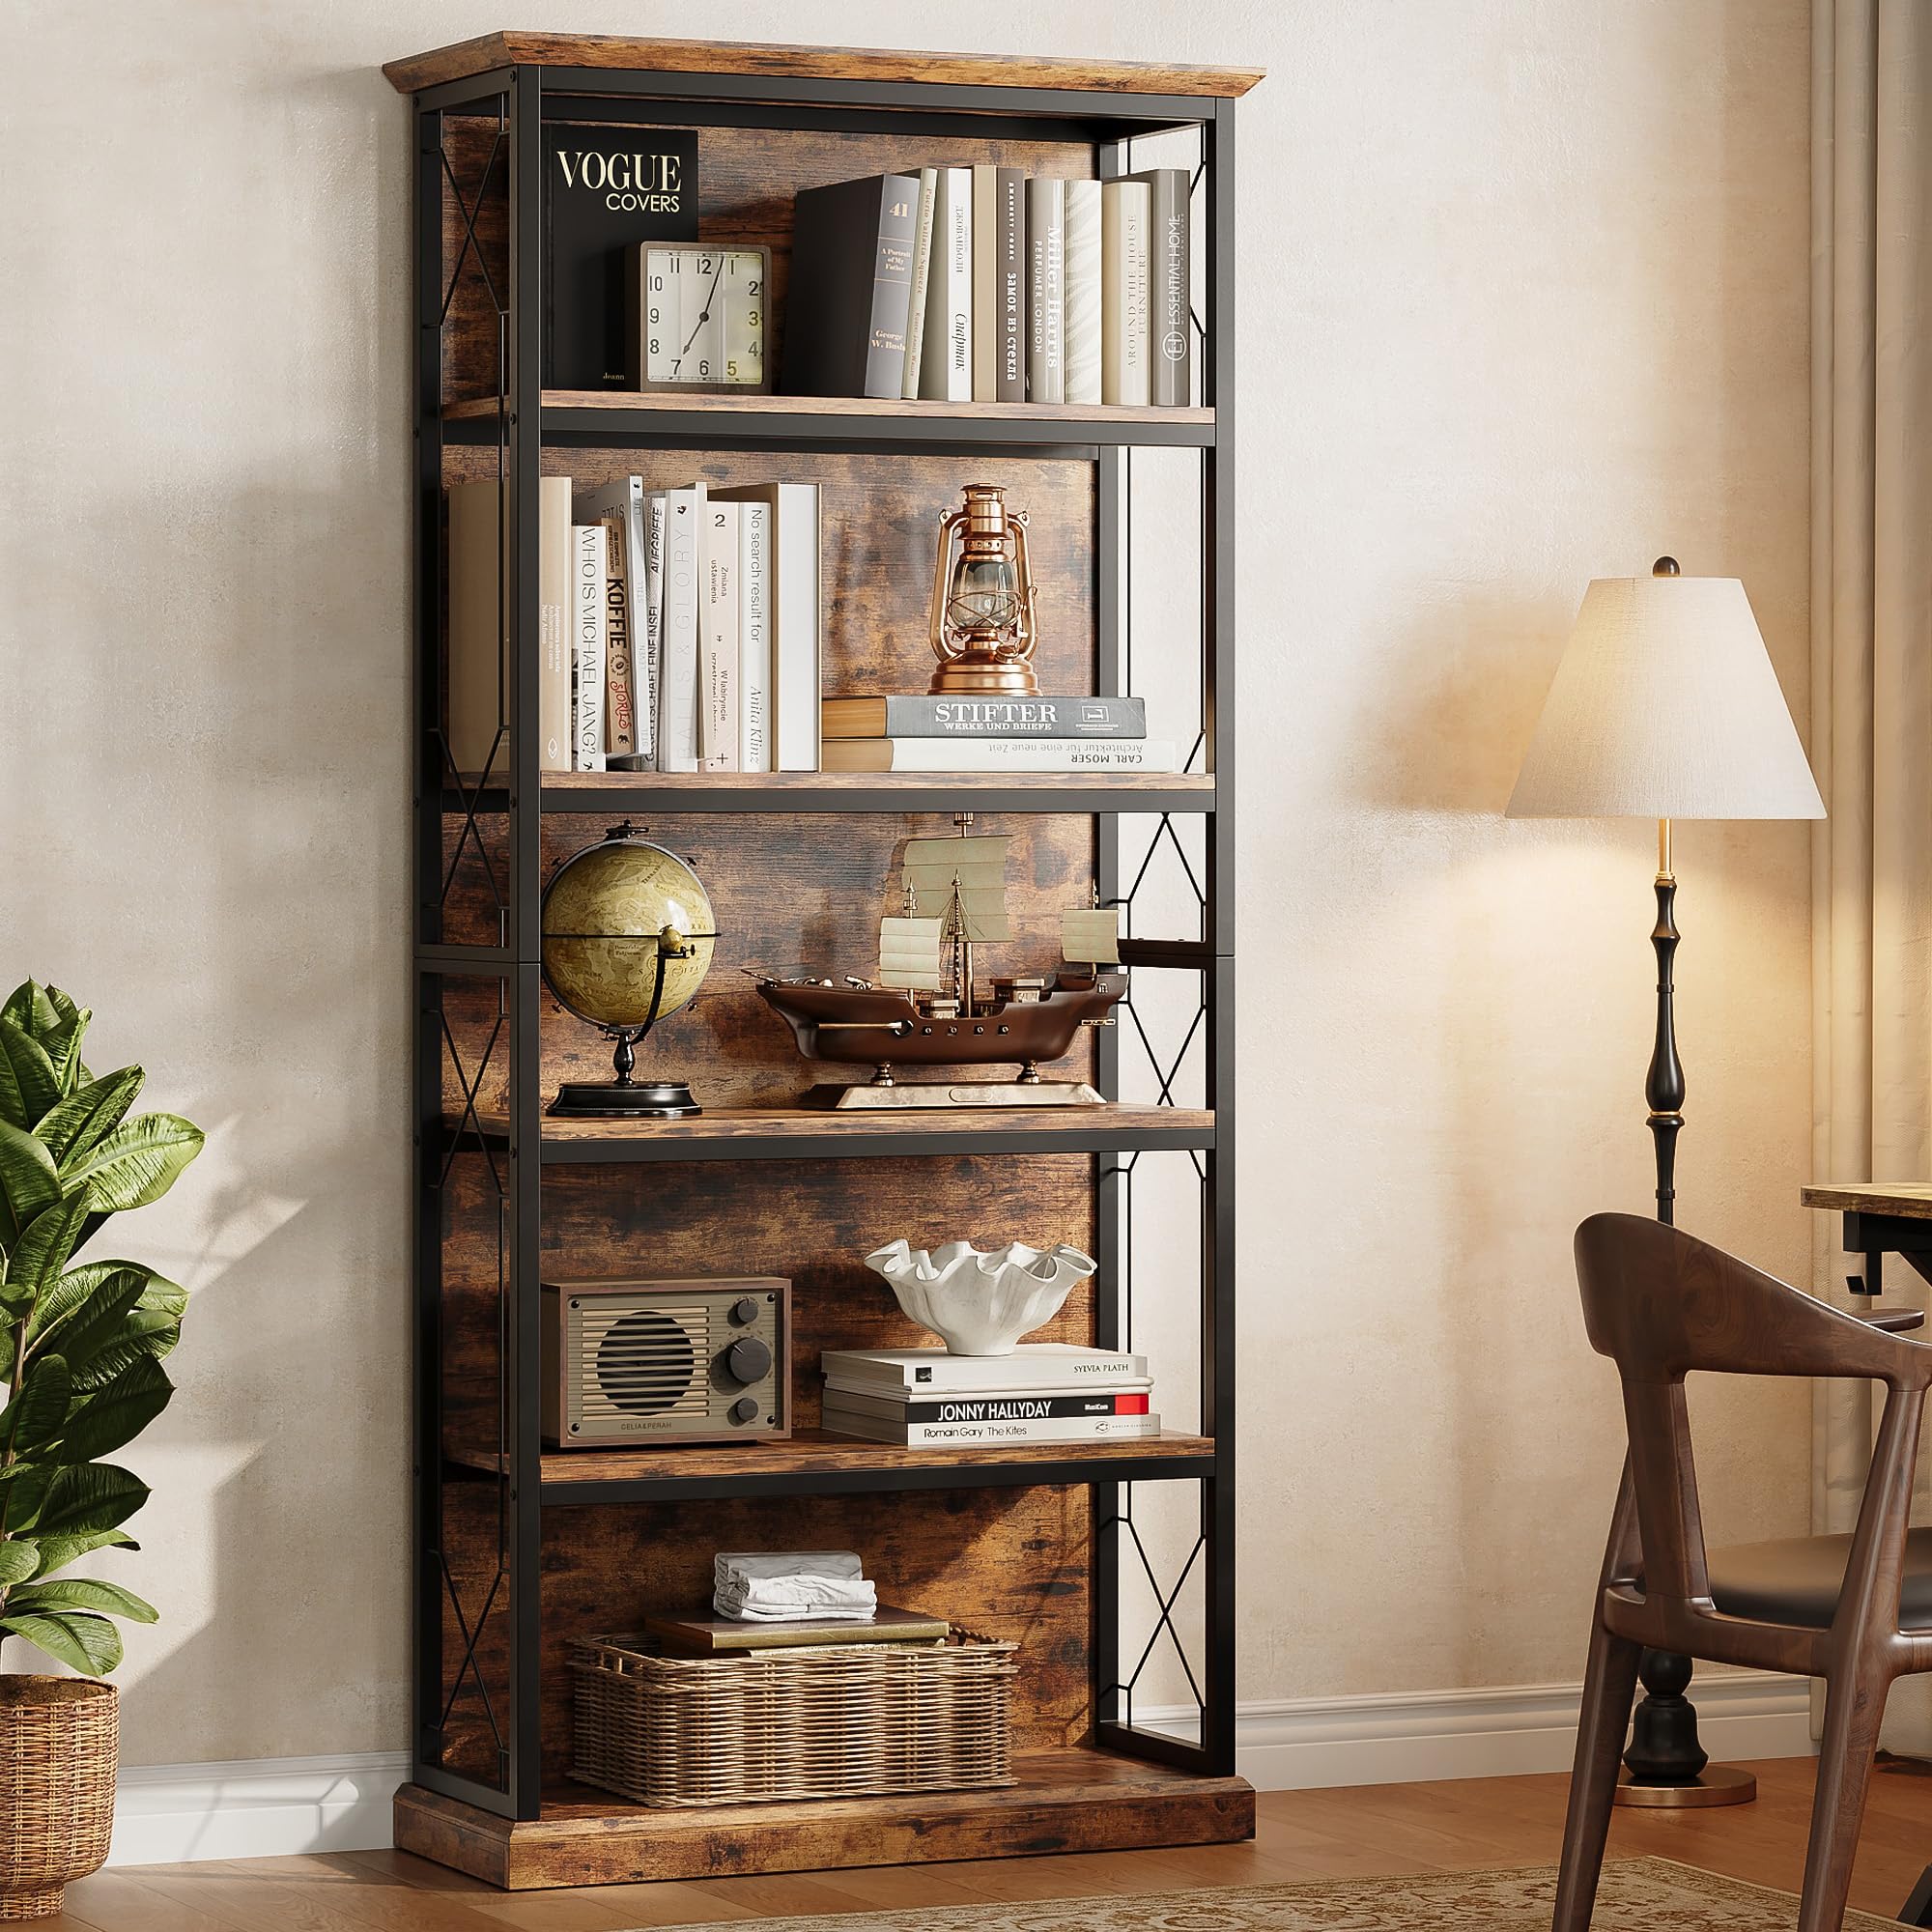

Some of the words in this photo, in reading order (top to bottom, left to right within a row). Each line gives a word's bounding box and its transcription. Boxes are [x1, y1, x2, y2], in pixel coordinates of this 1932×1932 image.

[556, 151, 682, 191] VOGUE
[606, 193, 680, 213] COVERS
[889, 202, 909, 217] 41
[1127, 214, 1137, 264] HOUSE
[1168, 214, 1180, 257] HOME
[670, 257, 680, 274] 11
[696, 258, 712, 274] 12
[730, 259, 735, 275] 1
[1047, 225, 1061, 294] Miller
[1035, 241, 1043, 298] PERFUMER
[649, 276, 663, 292] 10
[748, 280, 759, 296] 2
[1127, 266, 1137, 299] THE
[1168, 259, 1180, 326] ESSENTIAL
[649, 308, 660, 324] 9
[748, 310, 758, 326] 3
[875, 329, 903, 341] George
[952, 313, 967, 371] Спартак
[1047, 298, 1061, 369] Harris
[1127, 305, 1137, 369] AROUND
[649, 339, 660, 354] 8
[748, 341, 758, 356] 4
[871, 338, 884, 349] W.
[885, 341, 906, 353] Bush
[670, 359, 682, 375] 7
[698, 359, 710, 376] 6
[727, 360, 737, 376] 5
[1007, 336, 1016, 381] стекла
[714, 514, 726, 527] 2
[751, 509, 763, 528] No
[582, 527, 596, 579] WHO
[751, 530, 761, 580] search
[673, 528, 690, 629] GLORY
[710, 559, 719, 605] ustawienia
[582, 581, 596, 600] IS
[751, 582, 761, 620] result
[607, 579, 627, 649] KOFFIE
[751, 623, 762, 642] for
[582, 604, 596, 691] MICHAEL
[610, 680, 632, 730] STORIES
[750, 686, 762, 724] Anita
[935, 703, 1059, 723] STIFTER
[582, 693, 596, 753] JANG?
[944, 723, 983, 731] WERKE
[986, 723, 1009, 731] UND
[1012, 723, 1052, 731] BRIEFE
[750, 727, 763, 764] Klinz
[988, 744, 1009, 753] Zeit
[1011, 744, 1037, 753] neue
[1040, 744, 1063, 753] eine
[1065, 744, 1081, 754] für
[1084, 744, 1144, 753] Architektur
[1070, 754, 1110, 764] MOSER
[1114, 754, 1143, 764] CARL
[1073, 1364, 1101, 1374] SYLVIA
[1103, 1362, 1129, 1373] PLATH
[937, 1405, 985, 1422] JONNY
[987, 1401, 1052, 1419] HALLYDAY
[923, 1427, 959, 1438] Romain
[959, 1427, 983, 1440] Gary
[987, 1426, 1005, 1437] The
[1005, 1425, 1027, 1436] Kites
